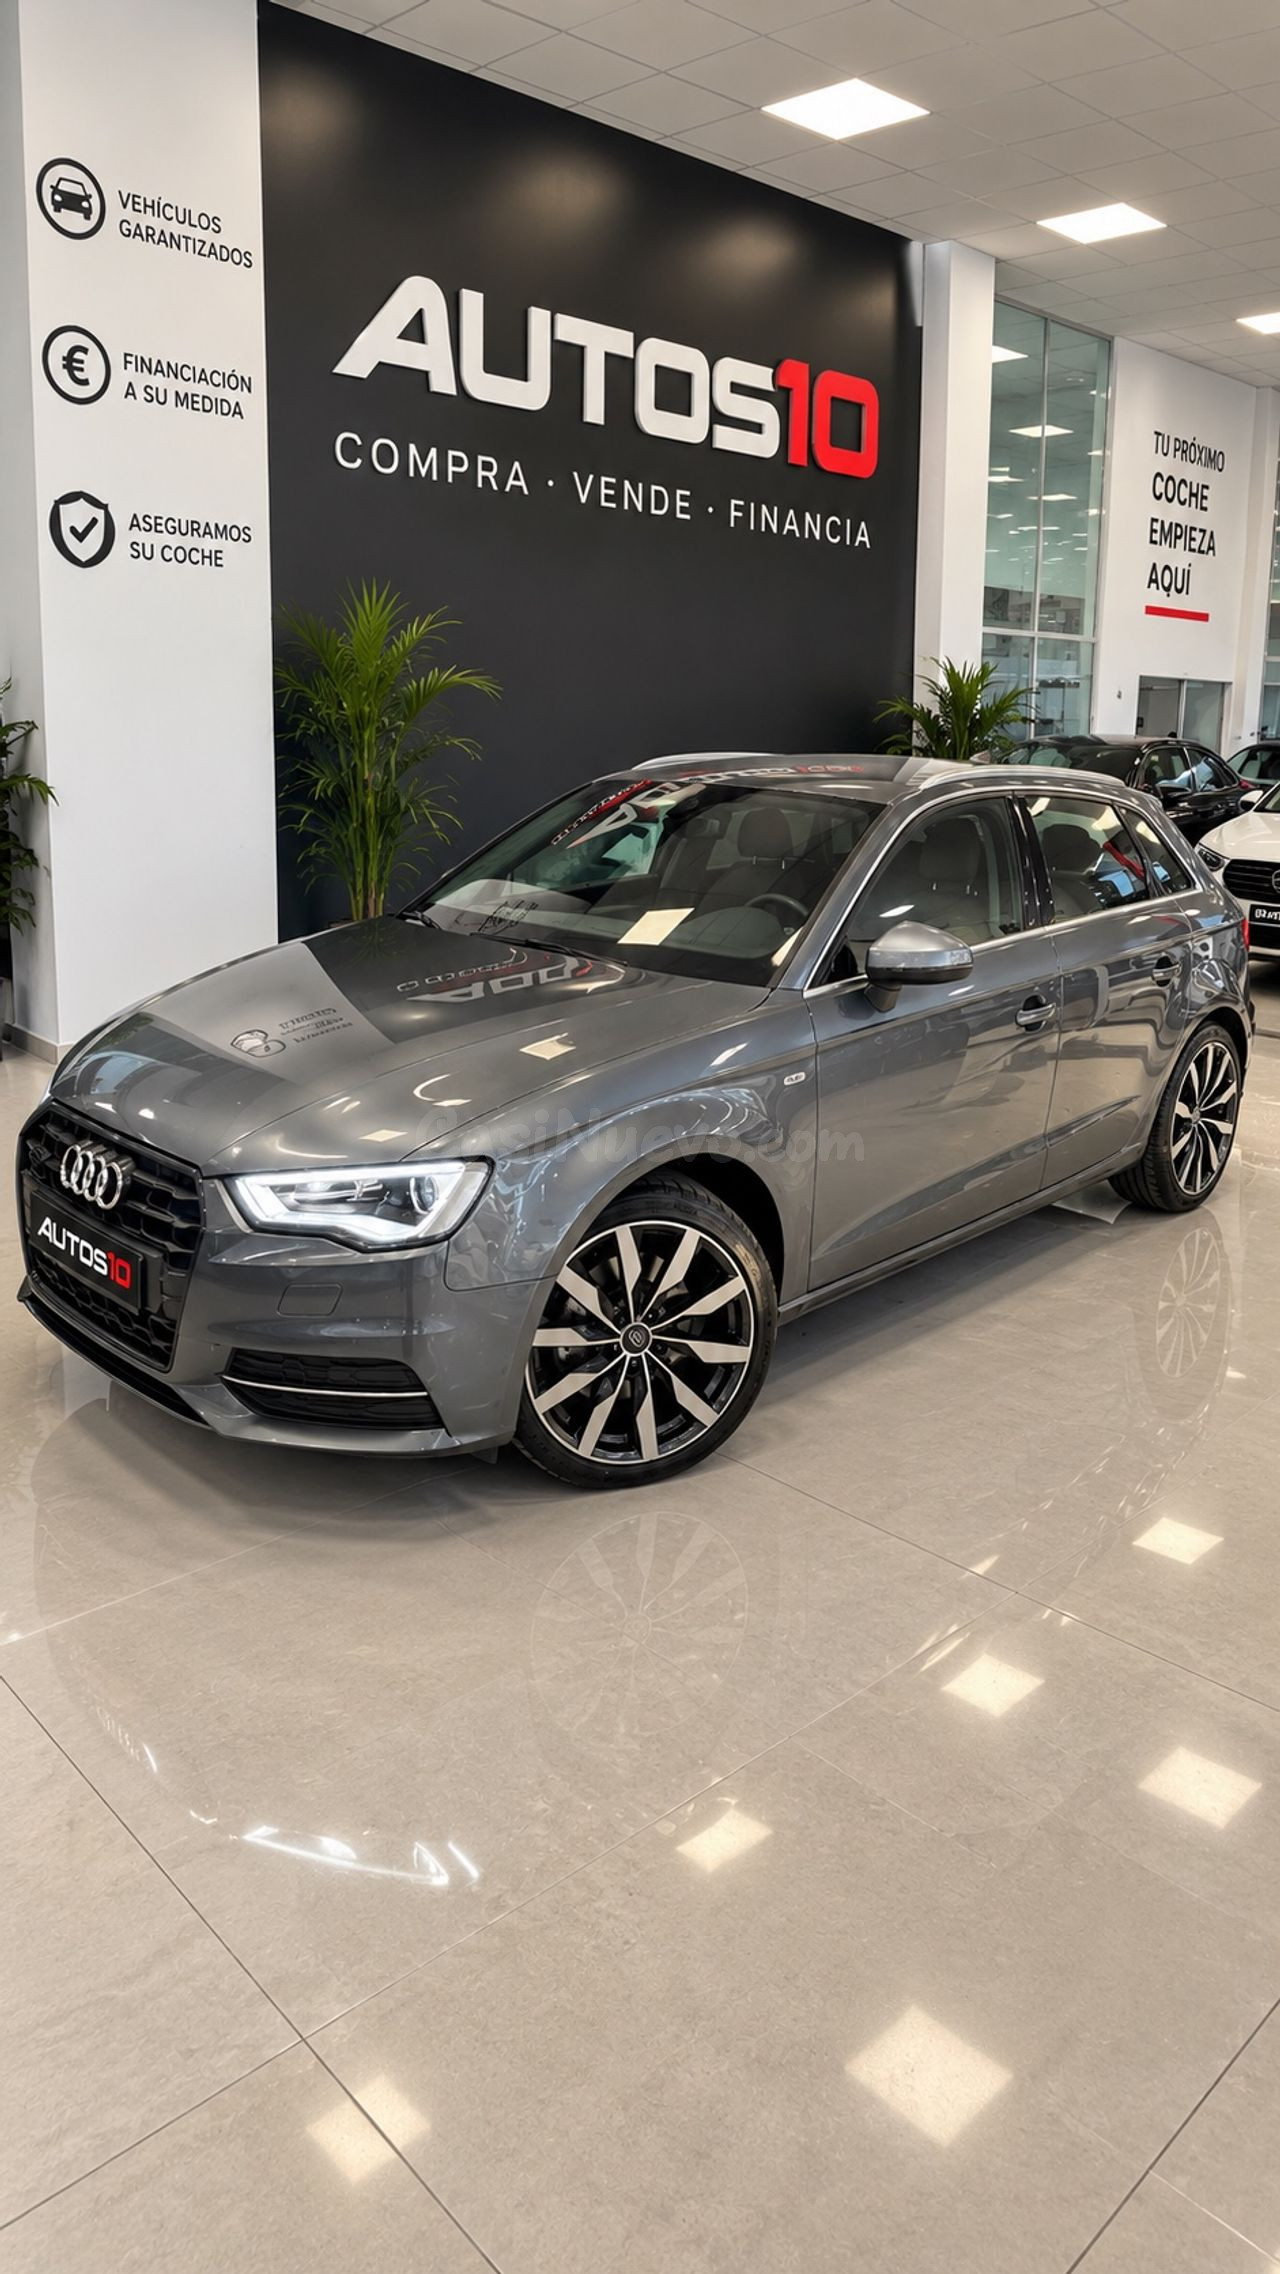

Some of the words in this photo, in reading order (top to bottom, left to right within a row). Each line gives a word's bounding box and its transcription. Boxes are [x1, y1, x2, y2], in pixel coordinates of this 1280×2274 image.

[118, 189, 222, 234] VEHÍCULOS
[118, 218, 253, 269] GARANTIZADOS
[123, 352, 252, 394] FINANCIACIÓN
[333, 275, 879, 479] AUTOS10
[124, 381, 138, 401] A
[144, 385, 168, 406] SU
[174, 390, 244, 420] MEDIDA
[1154, 431, 1170, 457] TU
[1173, 437, 1225, 473] PRÓXIMO
[335, 431, 529, 496] COMPRA
[573, 471, 691, 520] VENDE
[730, 498, 871, 549] FINANCIA
[1152, 471, 1210, 512] COCHE
[129, 513, 252, 544] ASEGURAMOS
[1149, 517, 1216, 557] EMPIEZA
[129, 541, 154, 561] SU
[161, 545, 224, 568] COCHE
[1147, 562, 1192, 597] AQUÍ
[37, 1216, 131, 1289] AUTOS10
